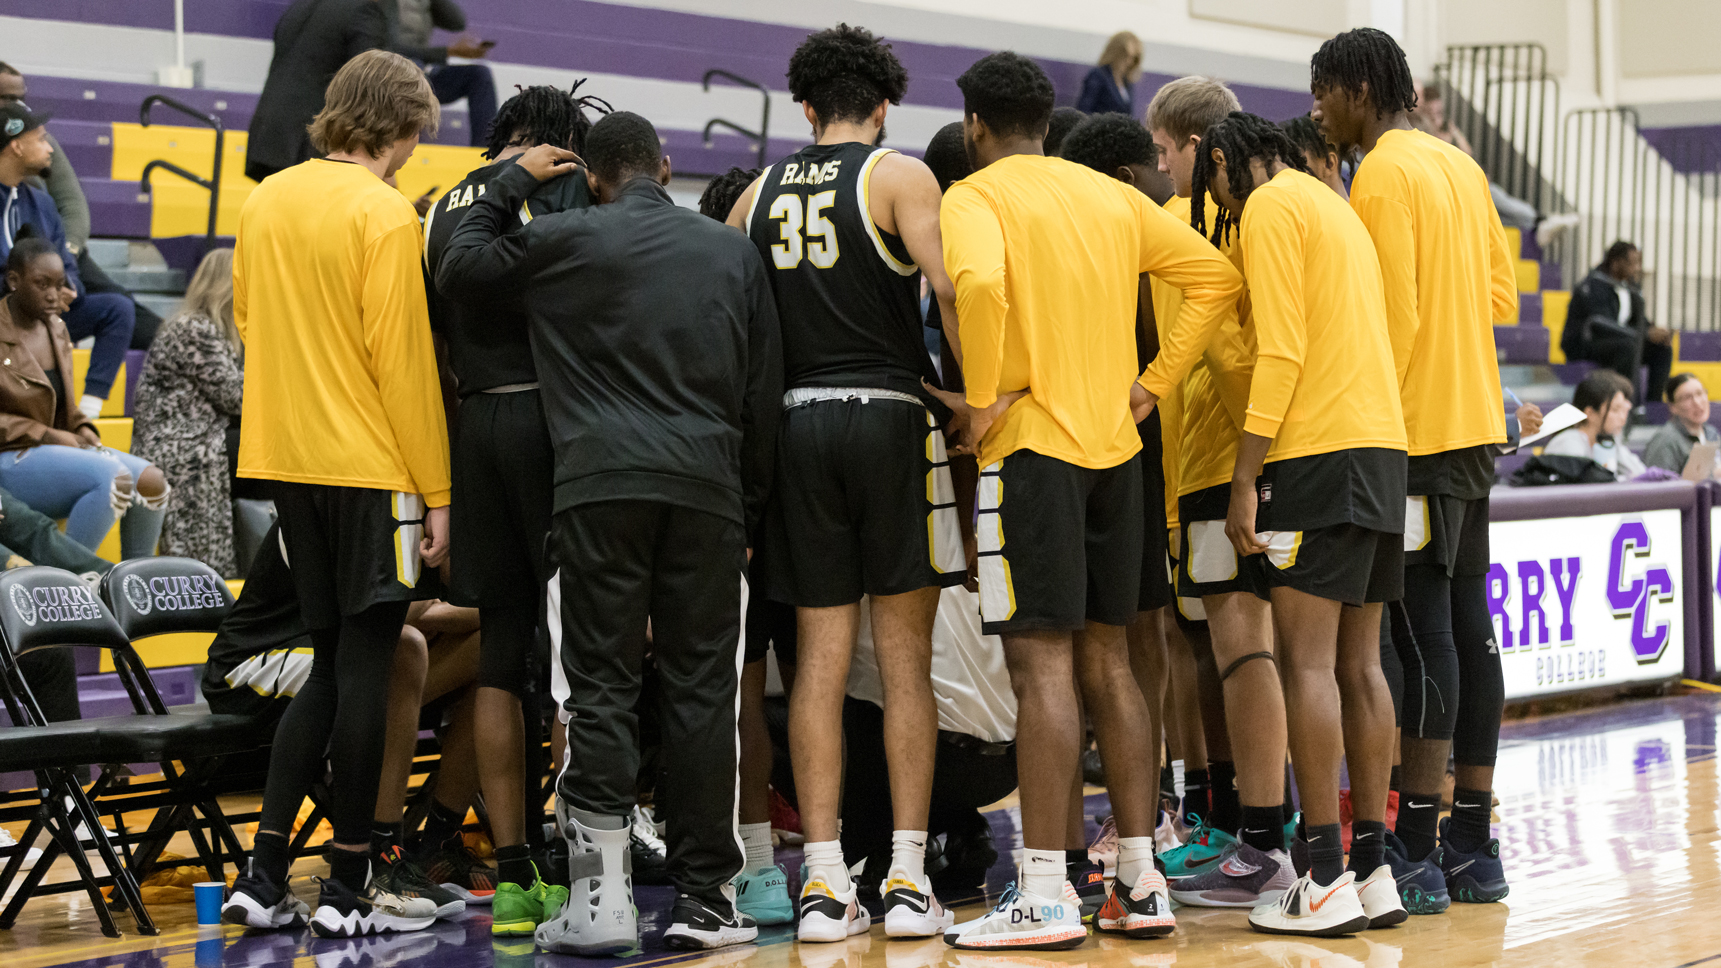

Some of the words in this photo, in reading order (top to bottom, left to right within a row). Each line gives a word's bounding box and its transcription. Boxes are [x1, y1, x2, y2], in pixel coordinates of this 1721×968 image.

[780, 160, 842, 186] RAMS
[769, 190, 840, 270] 35
[32, 585, 95, 607] CURRY
[150, 574, 219, 597] CURRY
[38, 604, 102, 622] COLLEGE
[155, 593, 225, 612] COLLEGE
